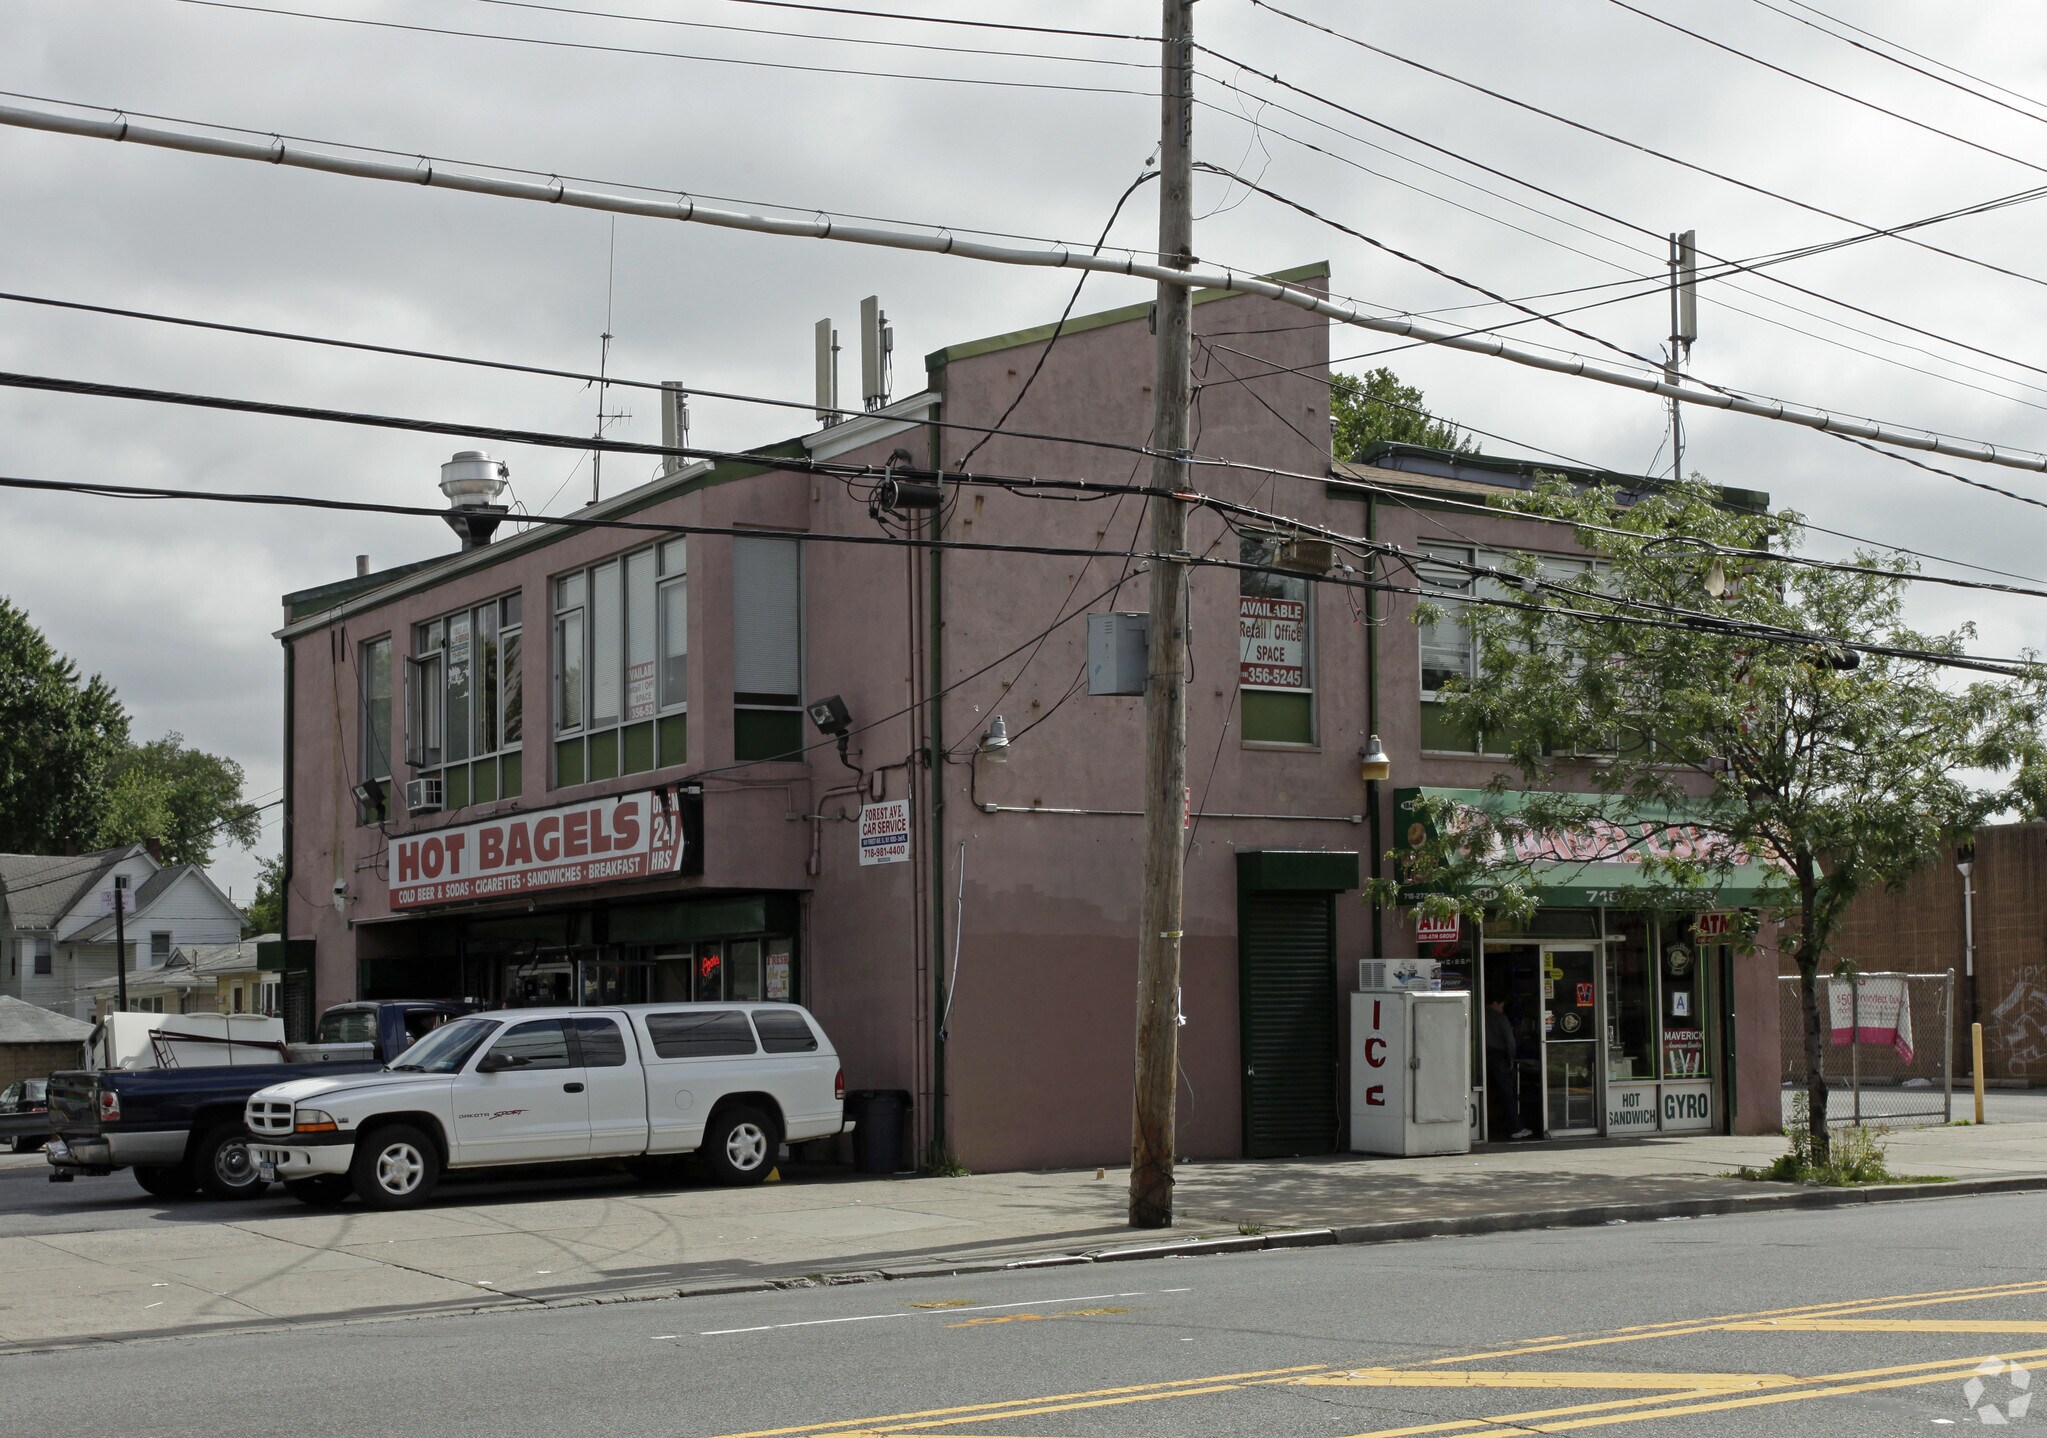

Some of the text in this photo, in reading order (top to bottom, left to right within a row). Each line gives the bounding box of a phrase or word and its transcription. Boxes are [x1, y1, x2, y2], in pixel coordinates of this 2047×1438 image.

[1241, 601, 1302, 619] AVAILABLE
[1240, 620, 1303, 642] Retail Office
[1256, 644, 1285, 662] SPACE
[1248, 666, 1301, 686] 356-5245
[635, 691, 652, 703] SPACE
[865, 807, 888, 821] FOREST
[652, 815, 677, 849] 24
[863, 819, 906, 835] CAR SERVICE
[397, 801, 641, 883] HOT BAGELS
[651, 848, 672, 871] HRS
[864, 845, 905, 858] 718-981-4400
[398, 857, 641, 904] COLD BEER & SODAS CIGARETTES SANDWICHES BREAKFAST
[1676, 995, 1685, 1009] A
[1664, 1030, 1704, 1041] MAVERICK
[1622, 1093, 1641, 1108] HOT
[1664, 1093, 1708, 1120] GYRO
[489, 1109, 530, 1120] SPORT
[1609, 1109, 1656, 1126] SANDWICH
